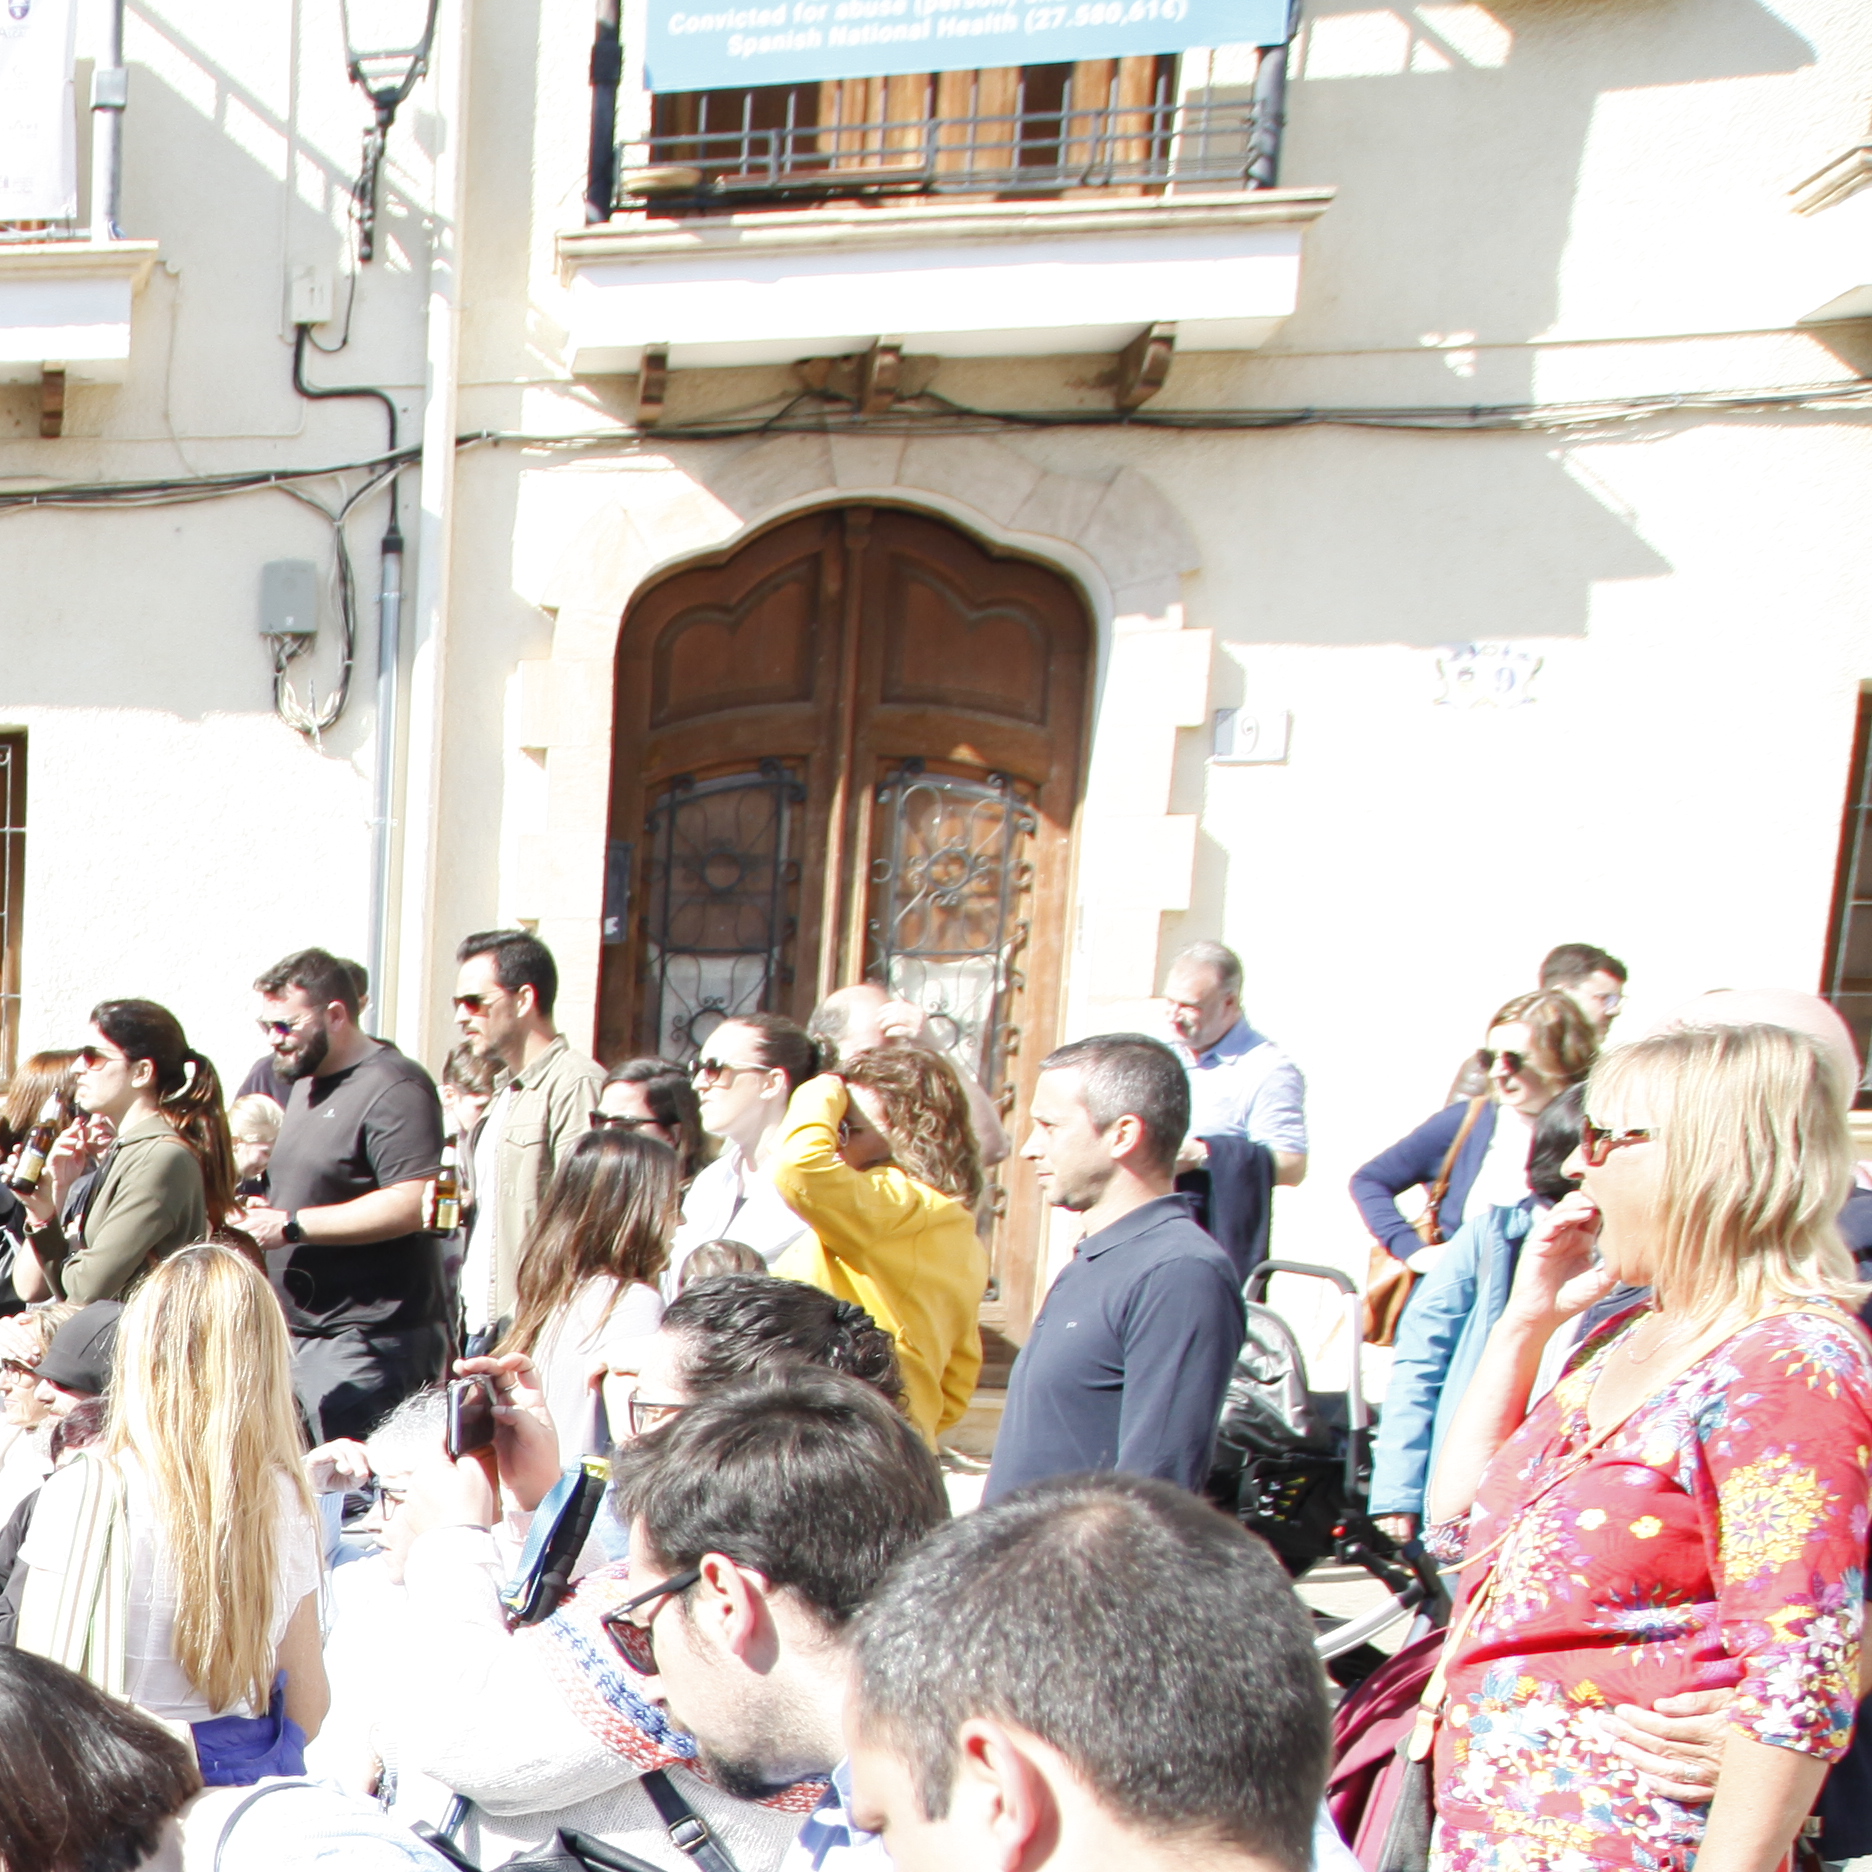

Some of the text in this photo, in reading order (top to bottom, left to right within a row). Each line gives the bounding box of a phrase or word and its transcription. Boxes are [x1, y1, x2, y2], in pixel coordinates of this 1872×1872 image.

[726, 28, 822, 60] Spanish
[828, 20, 931, 47] National
[937, 10, 1018, 39] Health
[1240, 715, 1259, 755] 9
